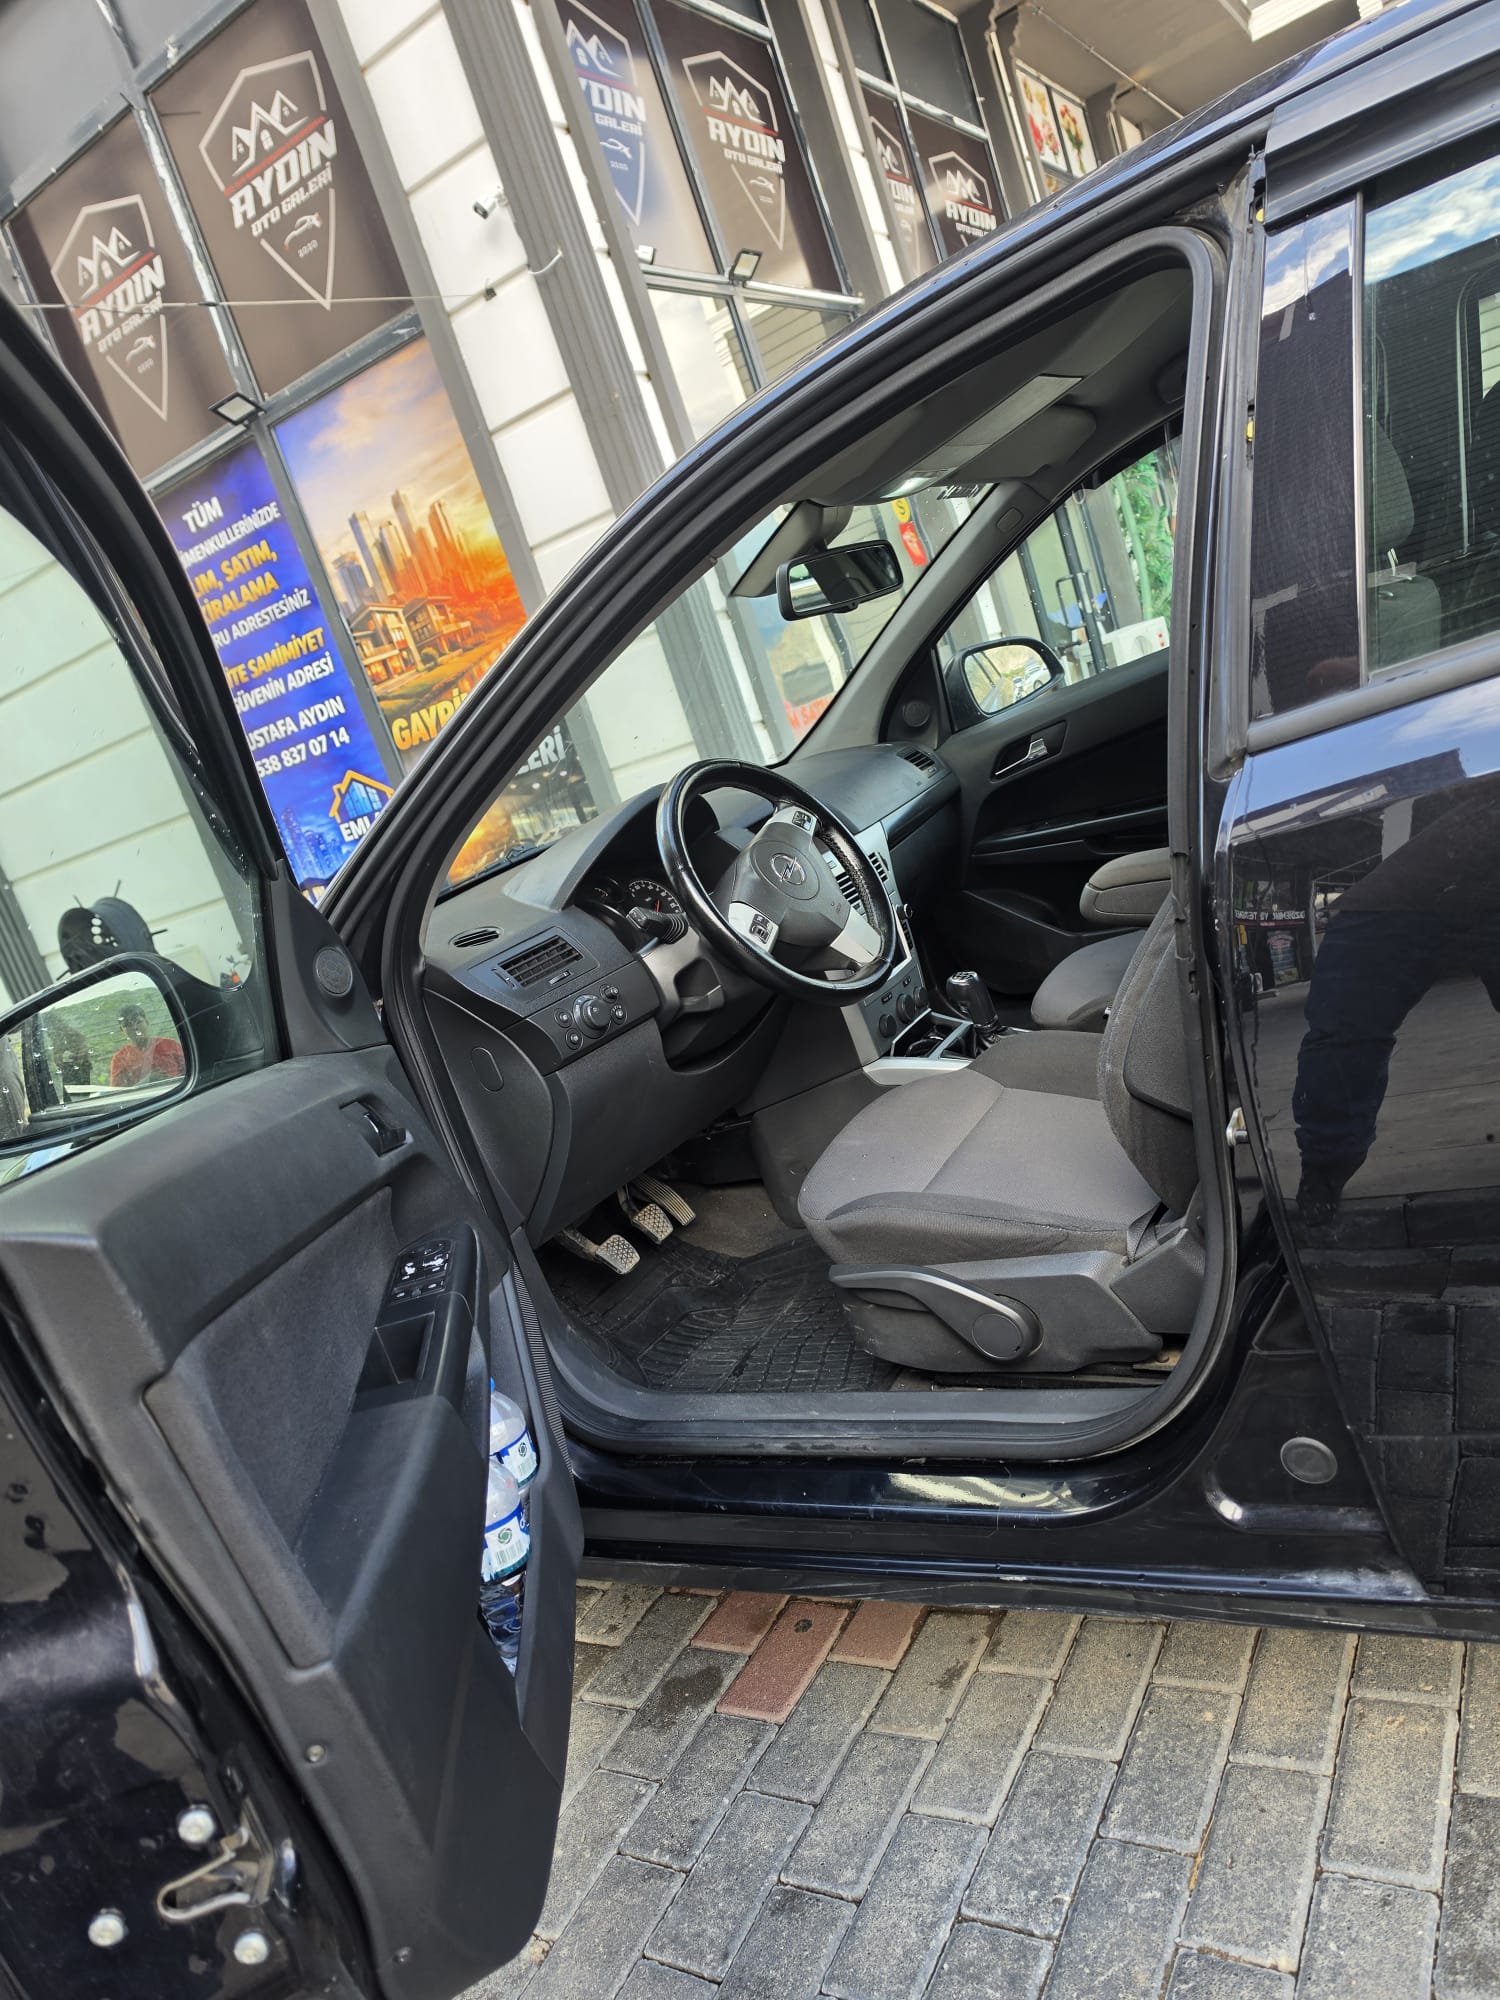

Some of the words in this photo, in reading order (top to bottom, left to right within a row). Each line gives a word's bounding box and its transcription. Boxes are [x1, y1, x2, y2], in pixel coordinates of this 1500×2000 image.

[706, 115, 786, 163] AYDIN
[229, 119, 337, 229] AYDIN
[251, 206, 281, 237] OTO
[281, 161, 333, 215] GALERİ
[945, 199, 997, 231] AYDIN
[78, 254, 165, 345] AYDIN
[182, 496, 224, 533] TÜM
[220, 539, 278, 582] SATIM,
[231, 588, 312, 640] ADRESTESİNİZ
[247, 627, 324, 679] SAMİMİYET
[286, 650, 335, 692] ADRESİ
[298, 695, 346, 730] AYDIN
[281, 742, 307, 767] 837
[308, 734, 327, 757] 07
[329, 726, 350, 748] 14
